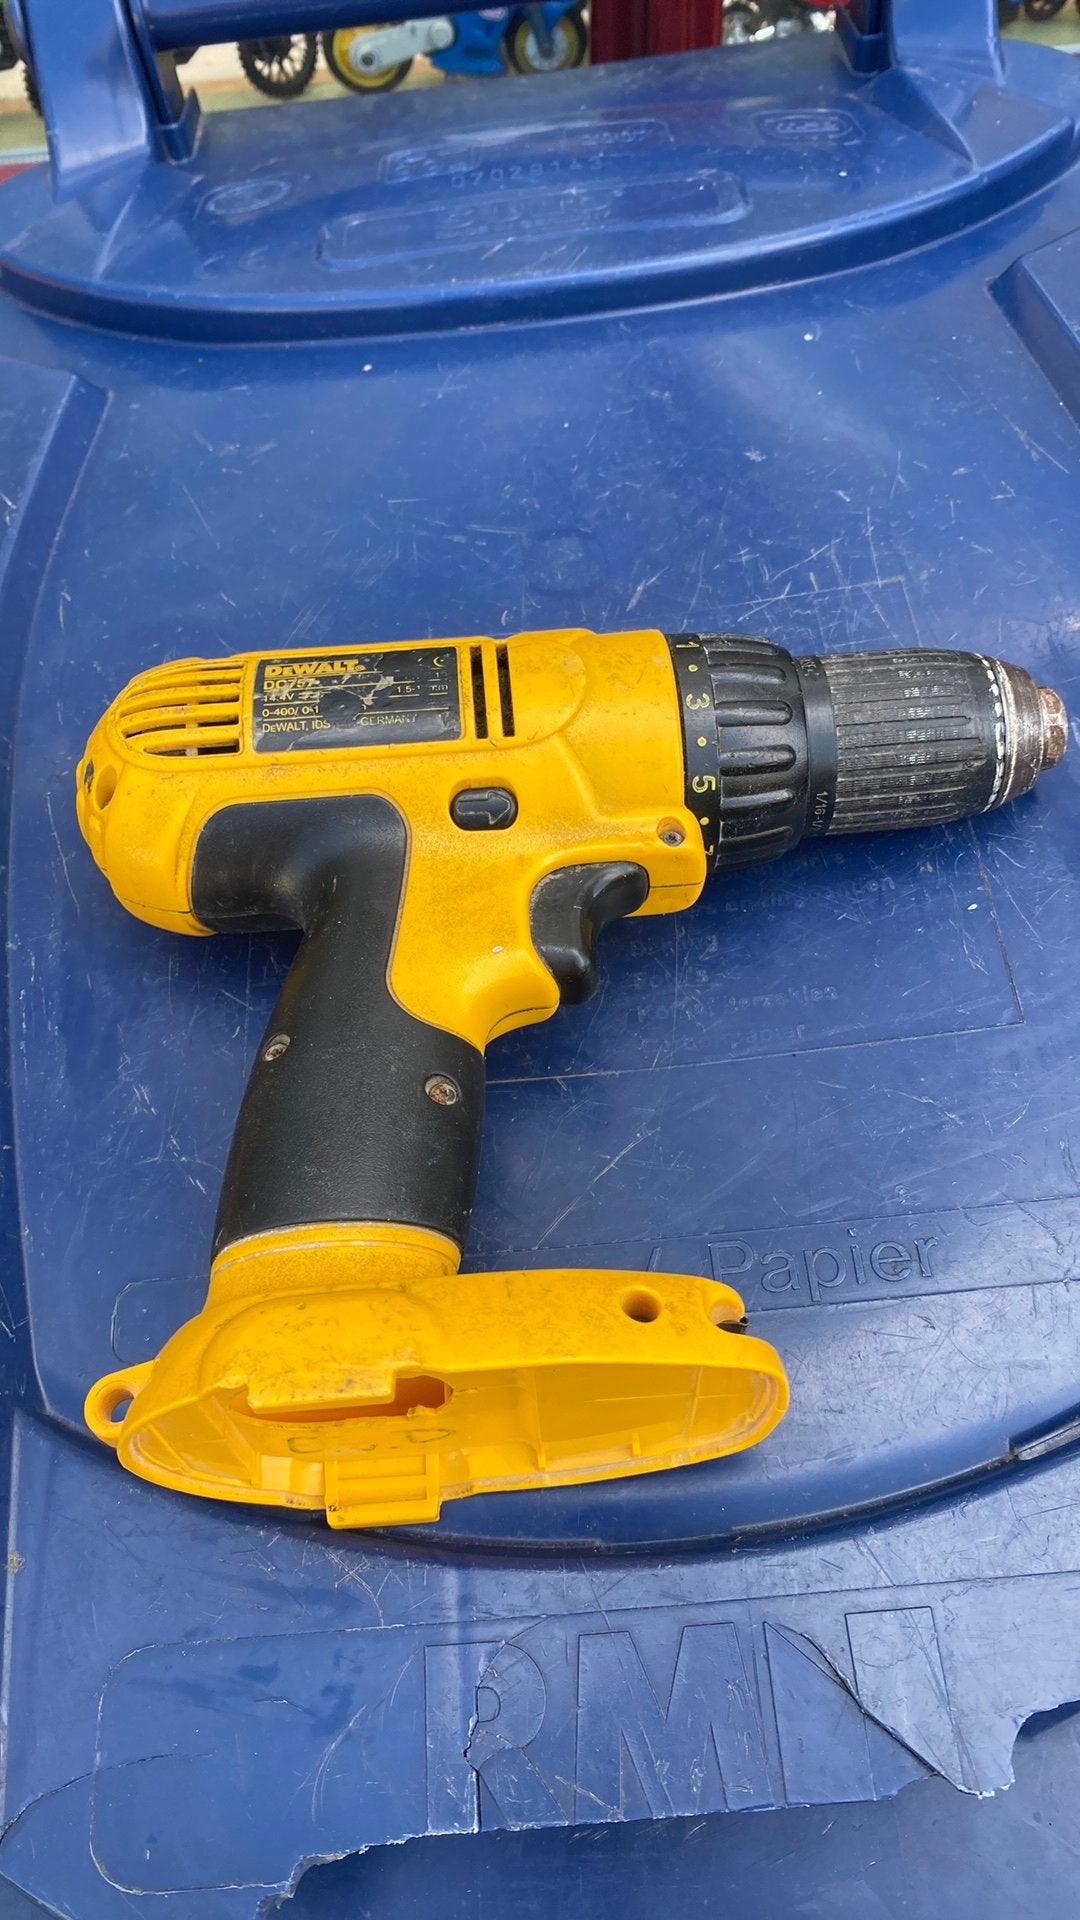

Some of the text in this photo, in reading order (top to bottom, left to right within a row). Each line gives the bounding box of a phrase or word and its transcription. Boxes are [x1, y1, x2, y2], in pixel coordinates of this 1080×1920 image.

[686, 692, 710, 710] 3
[692, 775, 716, 794] 5
[707, 1228, 939, 1303] Papier
